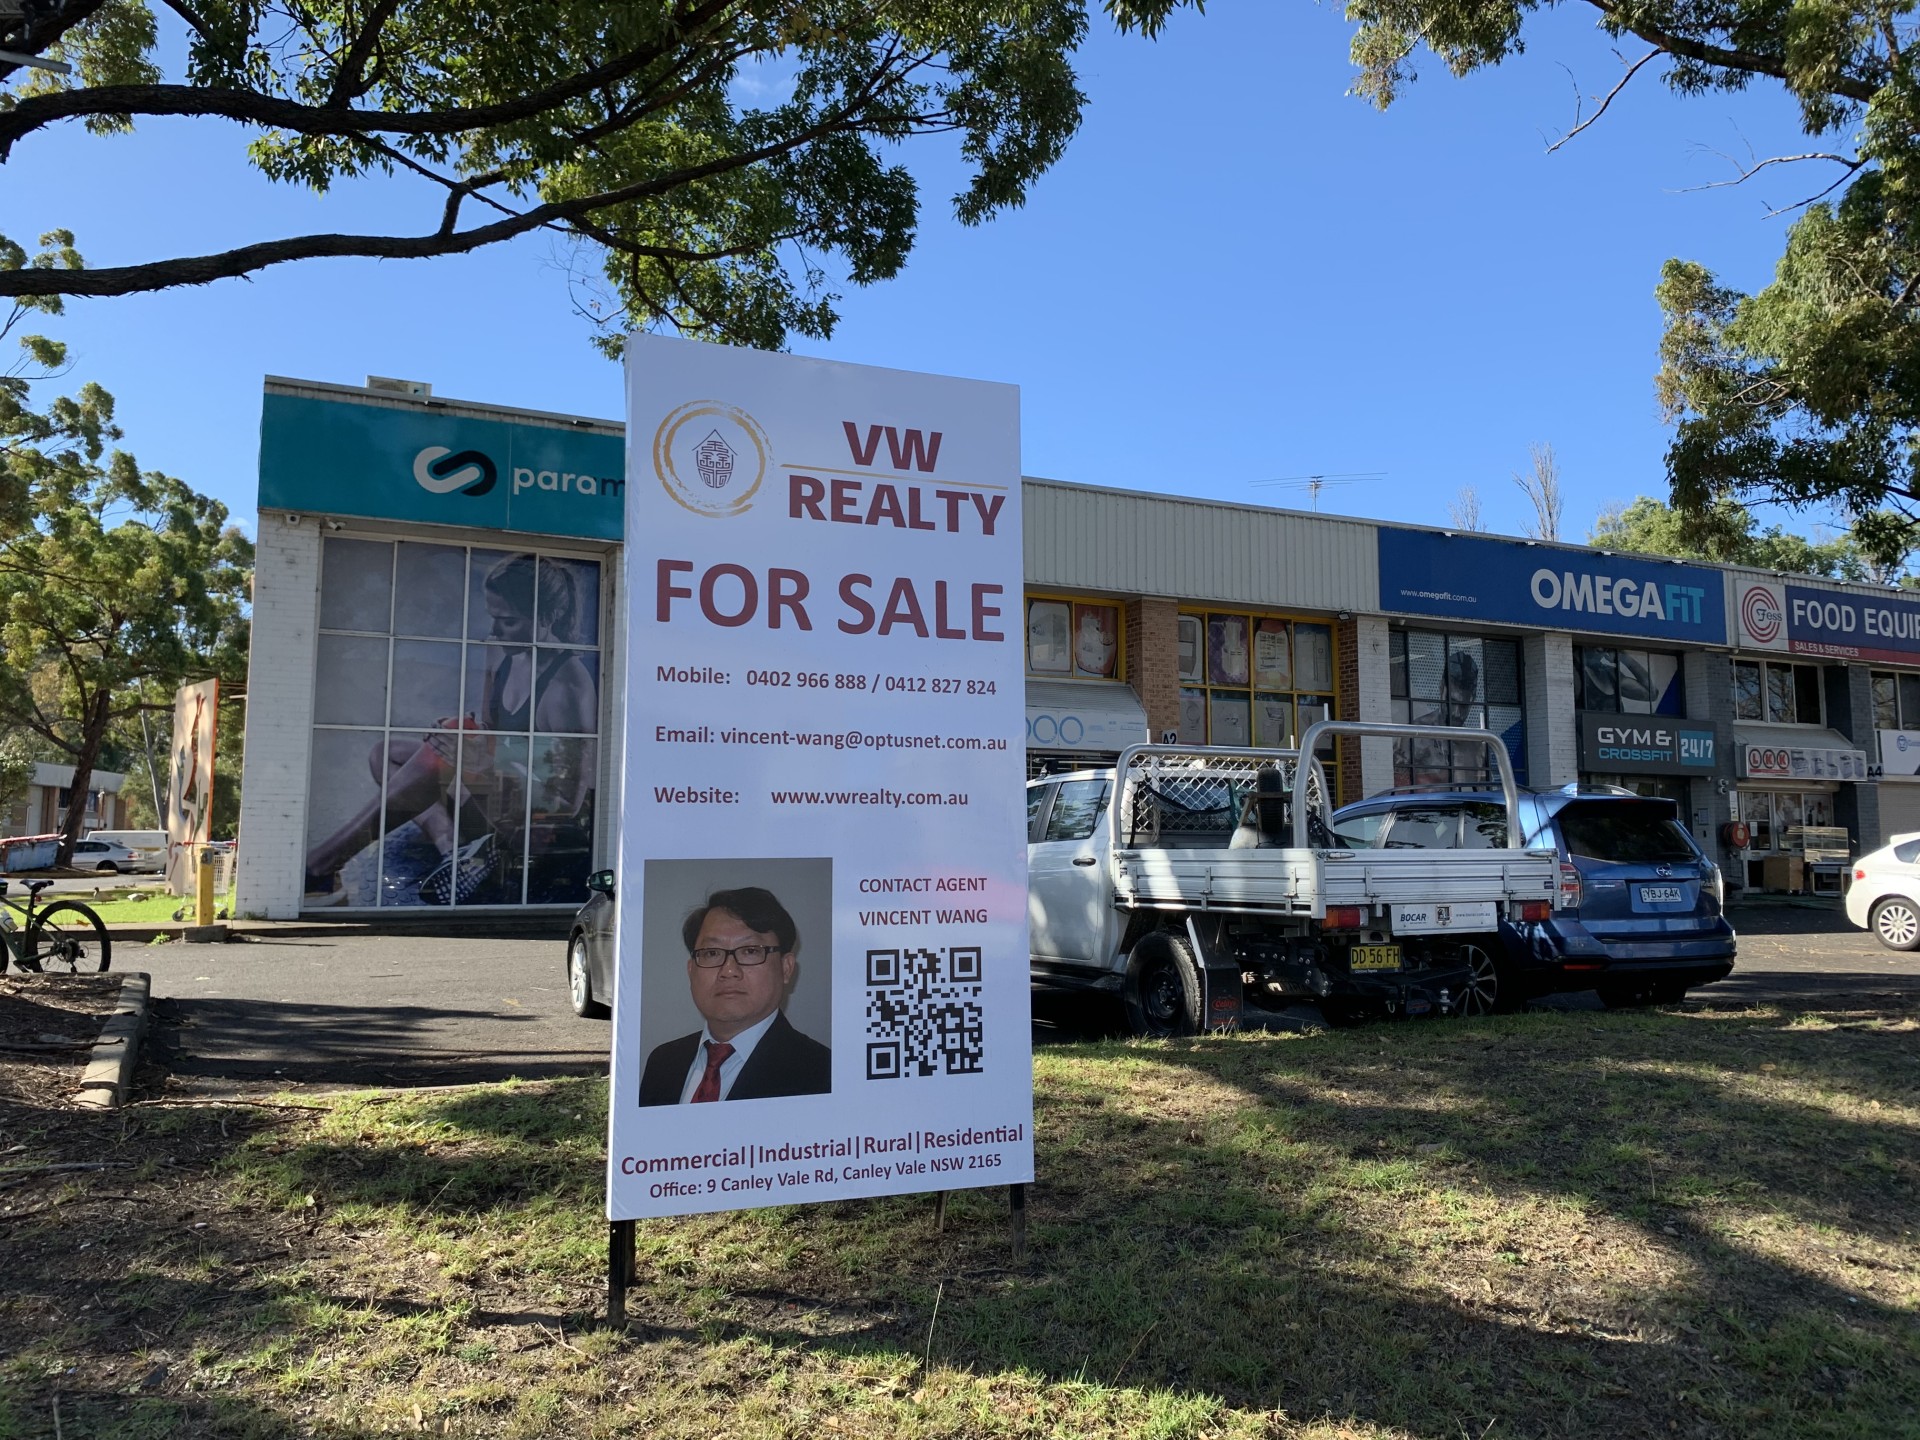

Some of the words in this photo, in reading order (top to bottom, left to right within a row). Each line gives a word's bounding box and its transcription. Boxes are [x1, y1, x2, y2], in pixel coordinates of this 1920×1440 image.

[842, 421, 943, 473] VW
[788, 474, 1006, 536] REALTY
[656, 559, 813, 632] FOR
[837, 572, 1005, 642] SALE
[1400, 589, 1477, 603] www.omegafit.com.au
[1756, 608, 1783, 622] Fess
[1792, 598, 1856, 633] FOOD
[1794, 641, 1818, 653] SALES
[1818, 644, 1824, 654] &
[1824, 645, 1859, 657] SERVICES
[656, 665, 731, 685] Mobile:
[746, 669, 792, 687] 0402
[796, 671, 830, 689] 966
[834, 672, 867, 690] 888
[885, 676, 927, 693] 0412
[931, 678, 961, 694] 827
[966, 679, 997, 696] 824
[654, 726, 715, 744] Email:
[720, 727, 1007, 751] vincent-wang@optusnet.com.au
[1597, 727, 1651, 746] GYM
[1655, 730, 1672, 746] &
[1598, 747, 1673, 762] CROSSFIT
[1866, 765, 1883, 778] A4
[653, 786, 740, 805] Website:
[770, 789, 969, 809] www.vwrealty.com.au
[859, 877, 932, 893] CONTACT
[935, 877, 988, 892] AGENT
[858, 910, 932, 926] VINCENT
[935, 908, 988, 924] WANG
[1400, 913, 1427, 922] BOCAR
[649, 1181, 702, 1199] Office:
[706, 1178, 717, 1193] 9
[720, 1173, 772, 1195] Canley
[776, 1169, 810, 1186] Vale
[814, 1167, 839, 1185] Rd,
[842, 1163, 892, 1184] Canley
[894, 1159, 927, 1176] Vale
[930, 1156, 965, 1173] NSW
[968, 1153, 1002, 1169] 2165
